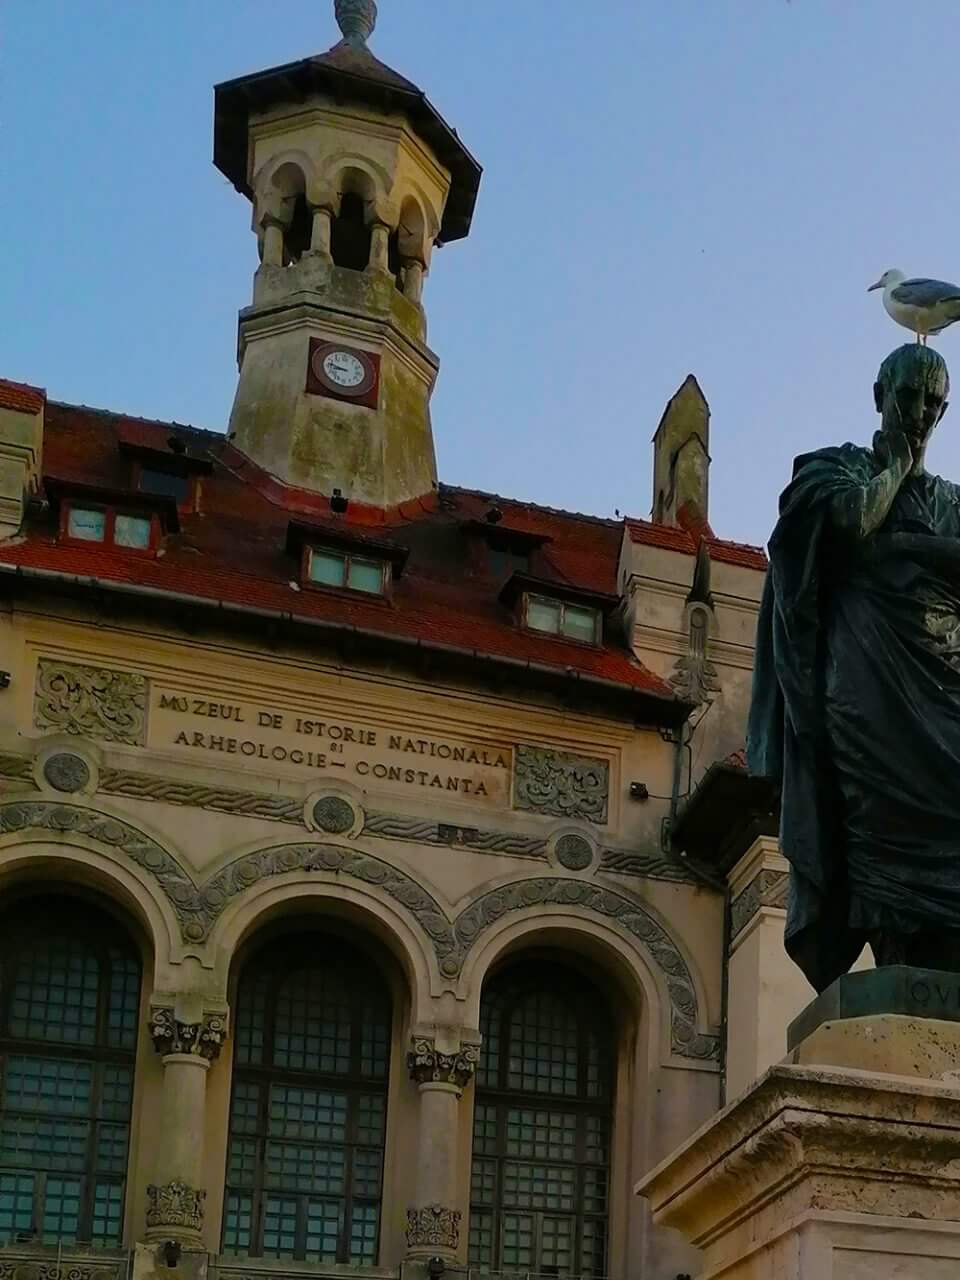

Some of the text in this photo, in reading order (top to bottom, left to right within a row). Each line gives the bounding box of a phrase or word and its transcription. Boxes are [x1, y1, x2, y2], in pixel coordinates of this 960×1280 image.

[159, 693, 509, 769] MUZEUL DE ISTORIE NATIONALA
[174, 730, 327, 769] ARHEOLOGIE
[355, 760, 490, 797] CONSTANTA
